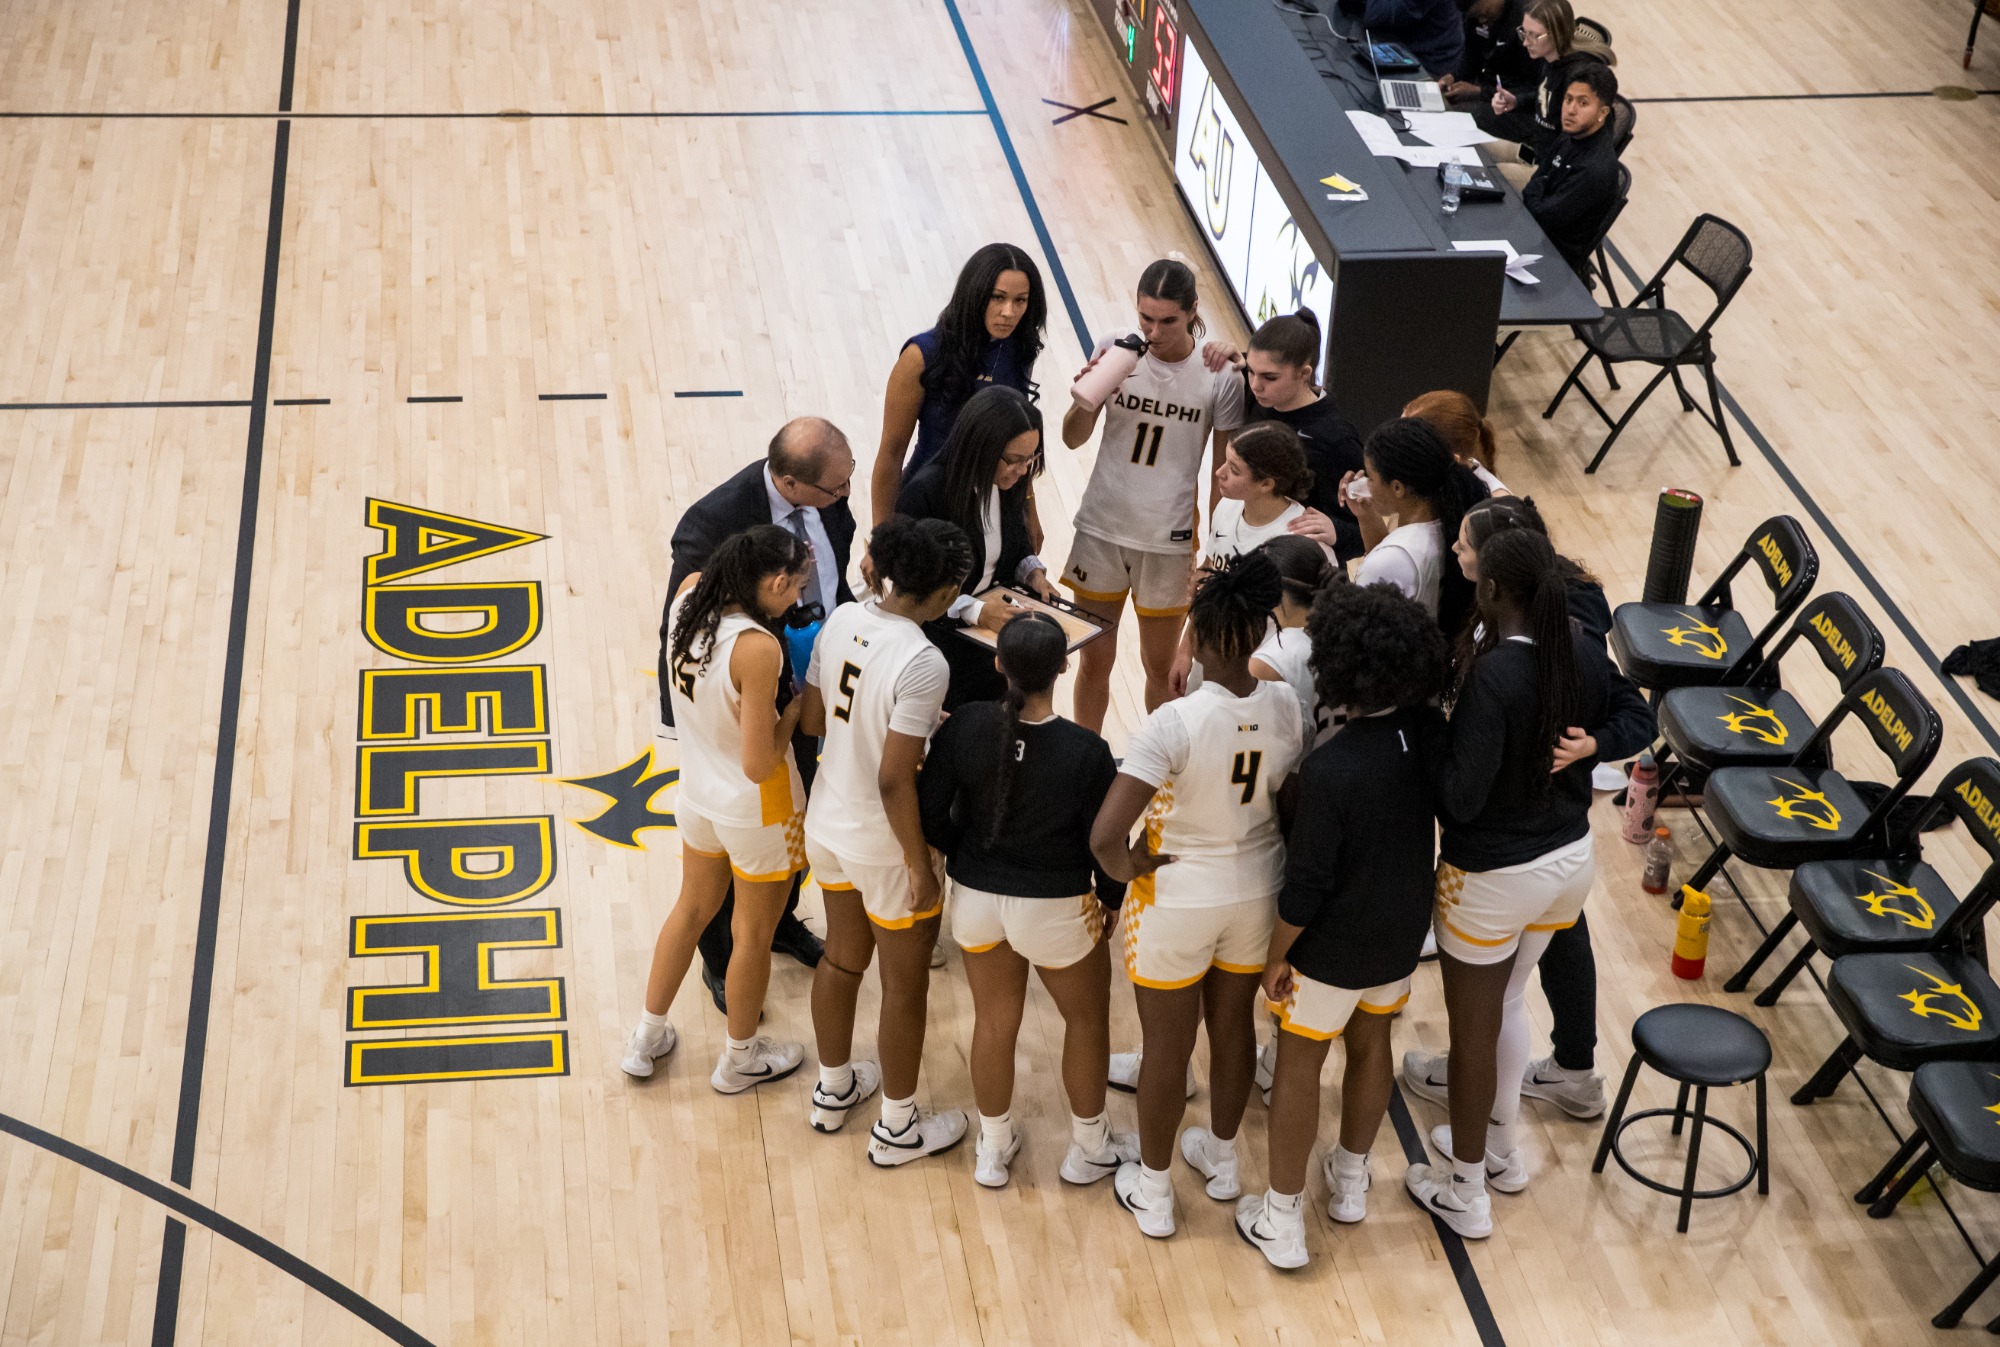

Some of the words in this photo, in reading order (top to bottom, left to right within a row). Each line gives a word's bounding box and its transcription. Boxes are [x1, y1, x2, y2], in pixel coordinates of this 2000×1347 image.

[1127, 24, 1135, 63] 4
[1152, 5, 1177, 105] 53
[1189, 74, 1235, 241] AU
[1114, 392, 1201, 423] ADELPHI
[1130, 421, 1165, 468] 11
[1757, 532, 1793, 588] ADELPHI
[1808, 610, 1857, 671] ADELPHI
[833, 659, 863, 724] 5
[1397, 728, 1409, 752] 1
[1860, 687, 1914, 753] ADELPHI
[1015, 739, 1026, 761] 3
[1231, 750, 1263, 806] 4
[344, 497, 570, 1087] ADELPHI
[1644, 863, 1655, 876] G
